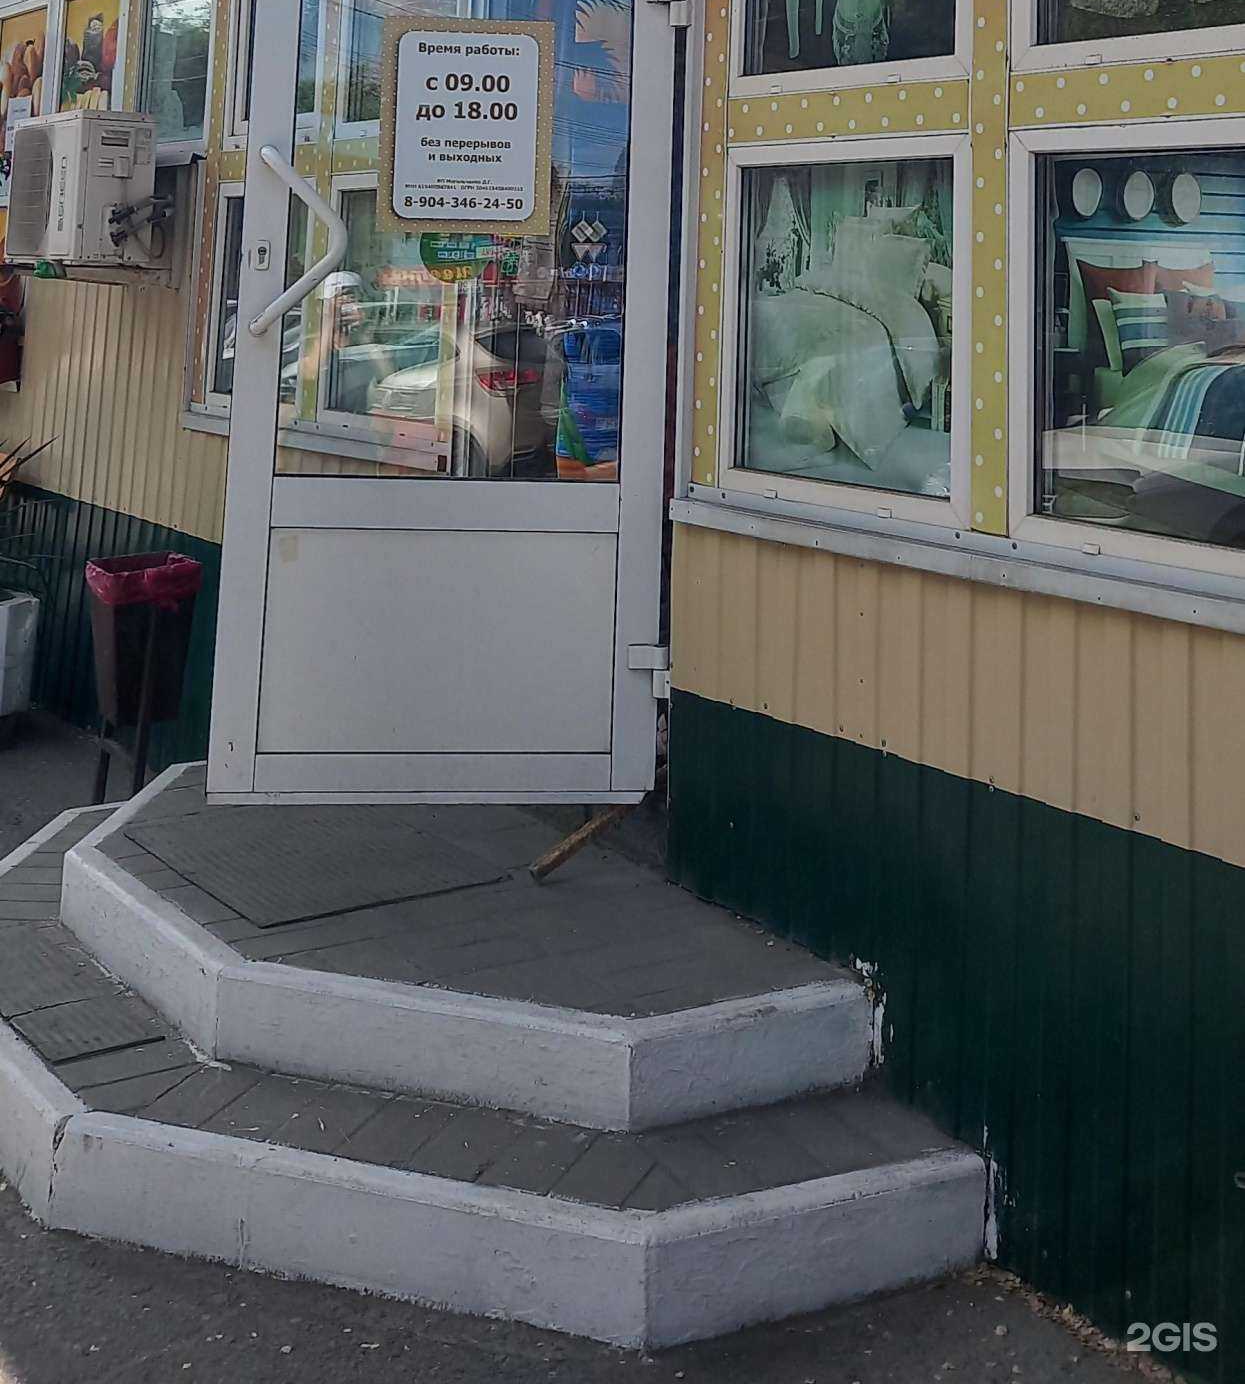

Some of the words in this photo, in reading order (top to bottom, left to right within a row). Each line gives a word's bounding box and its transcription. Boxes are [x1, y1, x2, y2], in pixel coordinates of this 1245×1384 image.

[418, 42, 461, 55] Время
[465, 44, 520, 56] работы:
[425, 76, 439, 91] с
[445, 73, 510, 93] 09.00
[415, 104, 446, 121] до
[454, 101, 518, 121] 18.00
[420, 137, 441, 147] без
[444, 139, 511, 150] перерывов
[428, 153, 436, 161] и
[439, 153, 503, 164] выходных
[403, 195, 524, 210] 8-904-346-24-50
